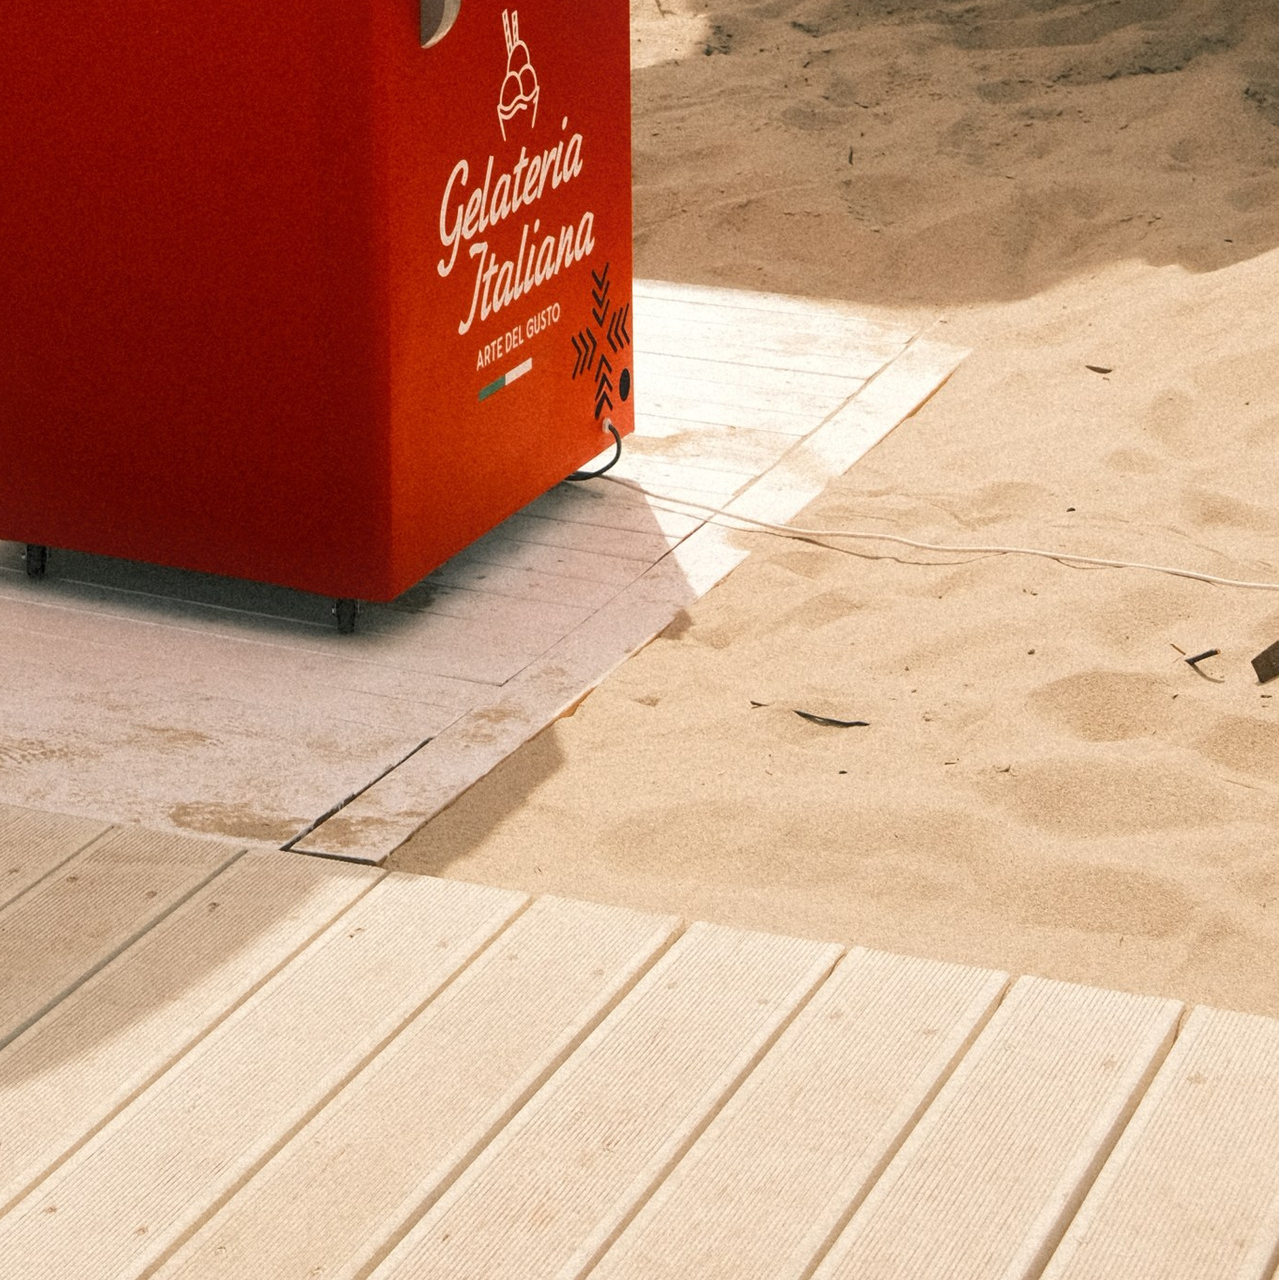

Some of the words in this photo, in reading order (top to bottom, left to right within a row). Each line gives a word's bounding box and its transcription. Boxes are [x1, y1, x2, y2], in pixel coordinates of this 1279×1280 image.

[437, 116, 583, 278] Gelateria
[458, 211, 595, 336] Italiana
[475, 333, 504, 372] ARTE
[504, 323, 525, 354] DEL
[525, 302, 562, 345] GUSTO
